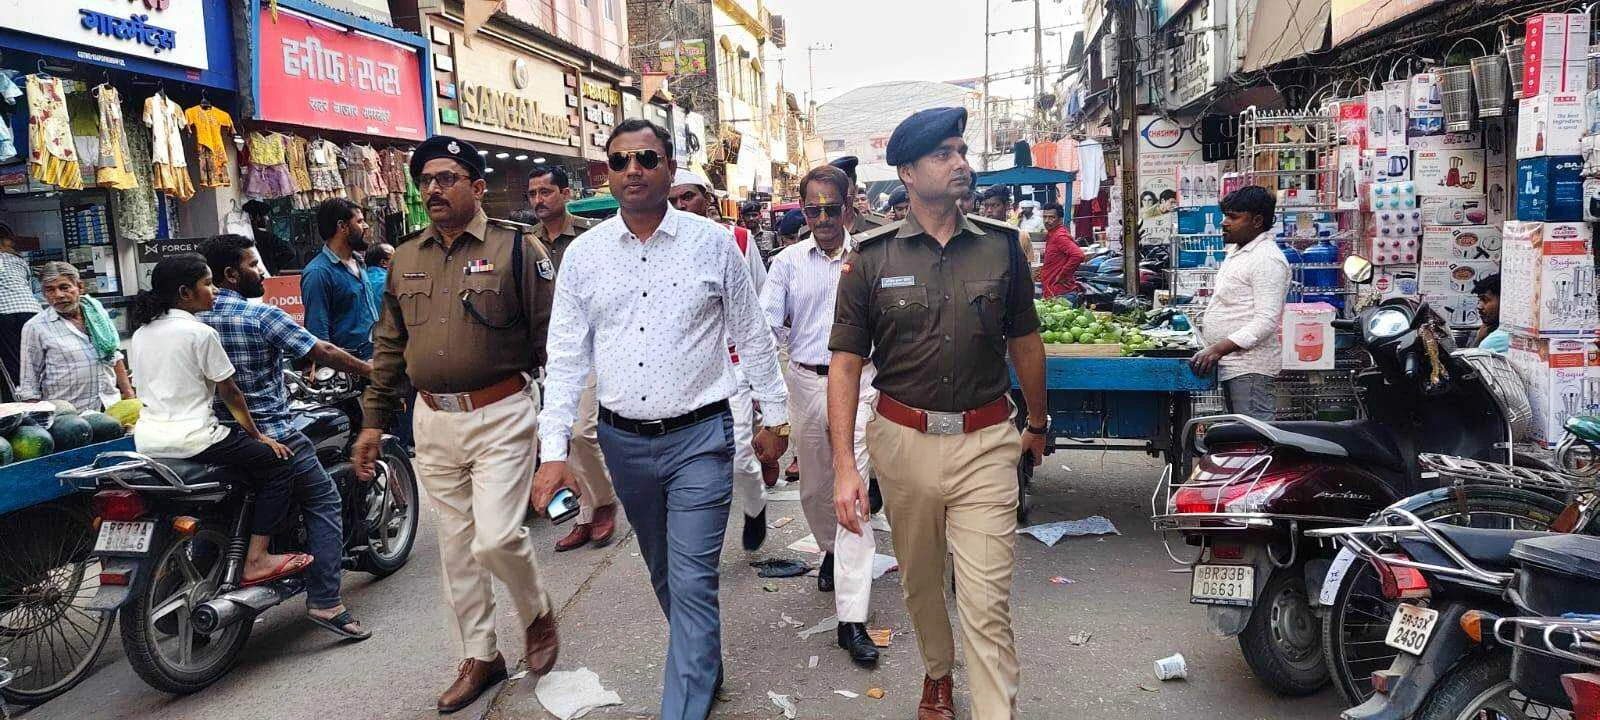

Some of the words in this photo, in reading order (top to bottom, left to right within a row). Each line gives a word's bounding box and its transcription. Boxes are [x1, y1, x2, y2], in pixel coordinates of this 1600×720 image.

[162, 244, 193, 252] FORCE
[1205, 567, 1245, 580] BR33B
[1400, 613, 1431, 630] BR-33X
[1393, 627, 1426, 650] 2430
